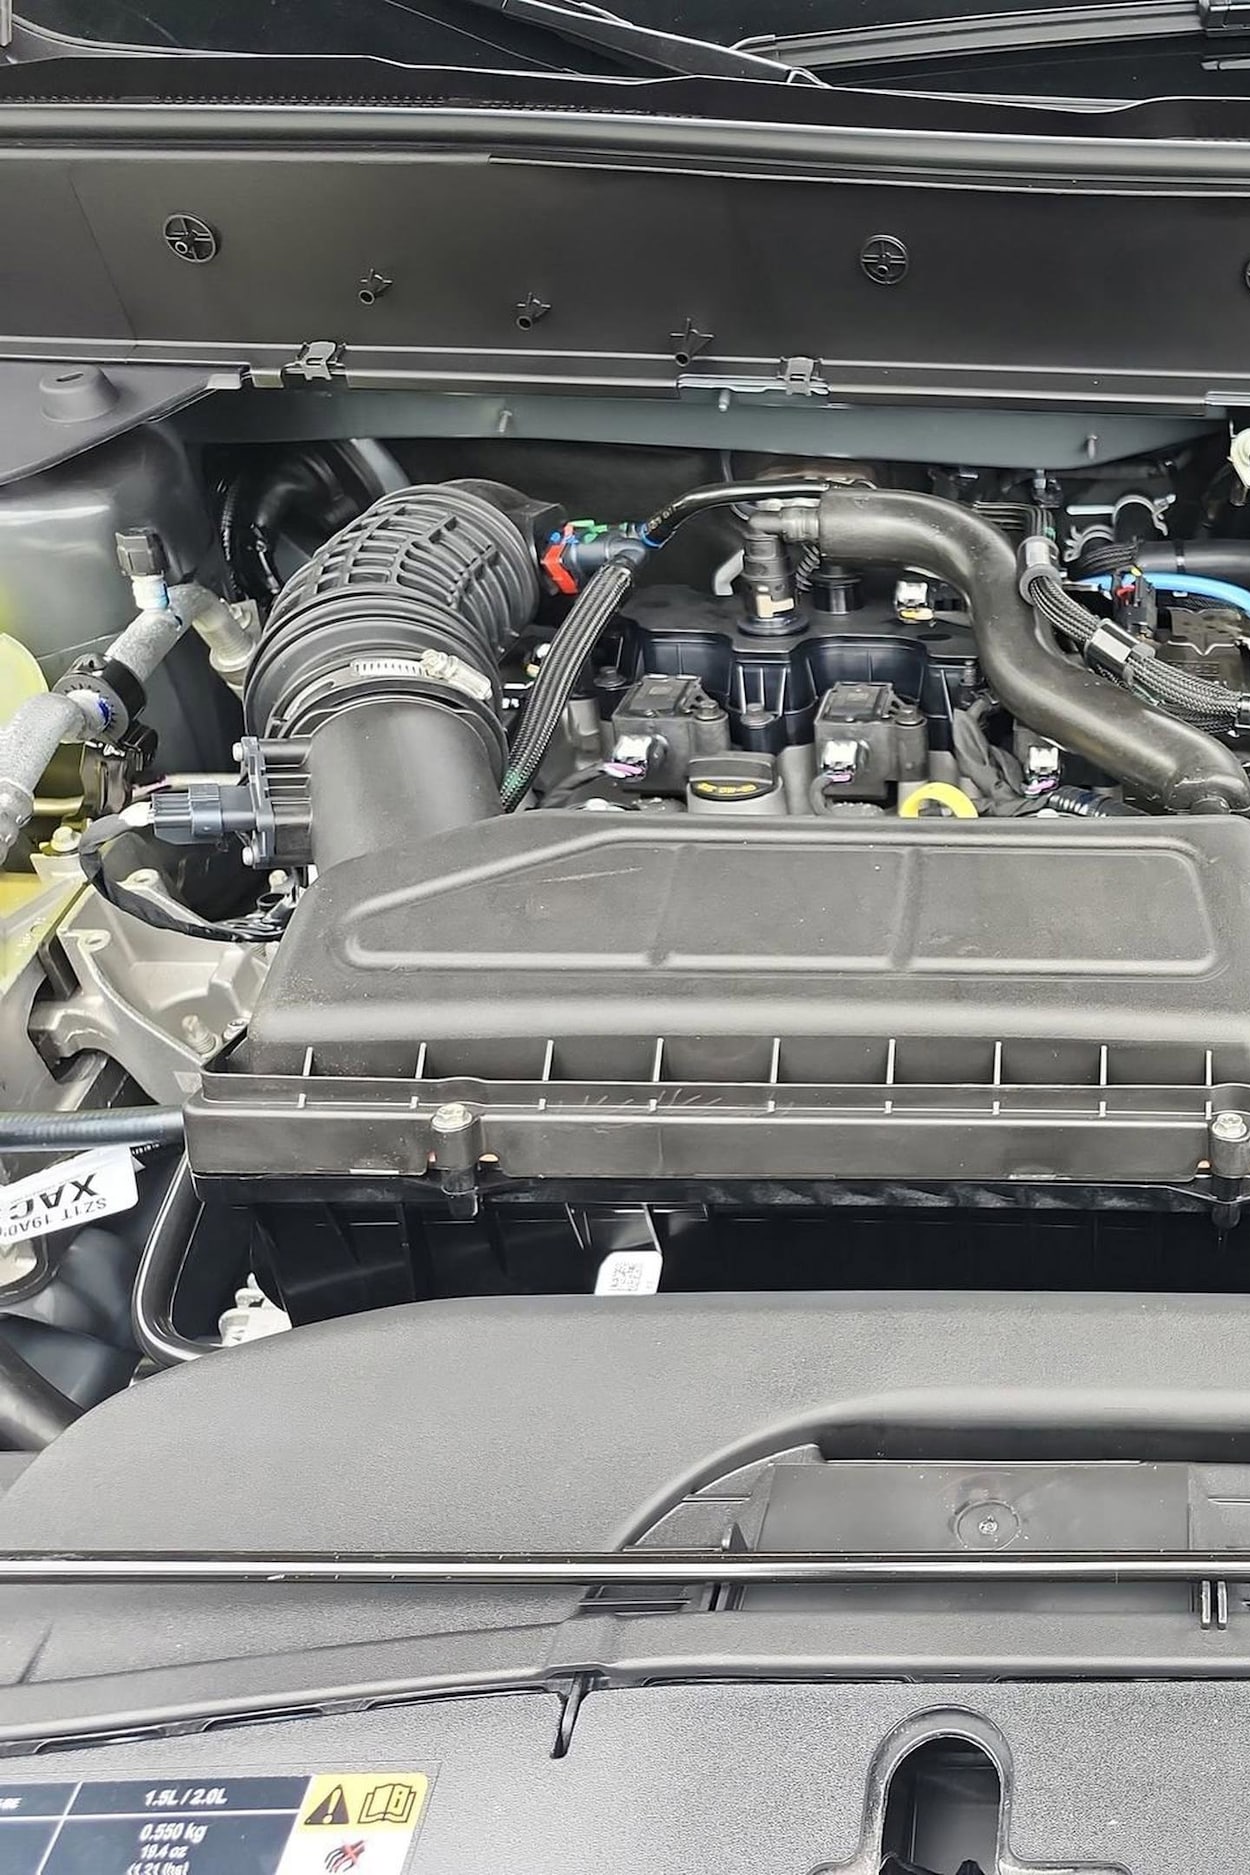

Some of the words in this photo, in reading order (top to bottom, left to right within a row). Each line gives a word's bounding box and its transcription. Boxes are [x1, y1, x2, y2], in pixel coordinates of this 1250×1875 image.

[0, 1172, 99, 1220] XAC
[145, 1789, 178, 1806] 1.5L
[190, 1788, 228, 1805] 2.0L
[140, 1823, 184, 1841] 0.550
[183, 1822, 208, 1844] kg
